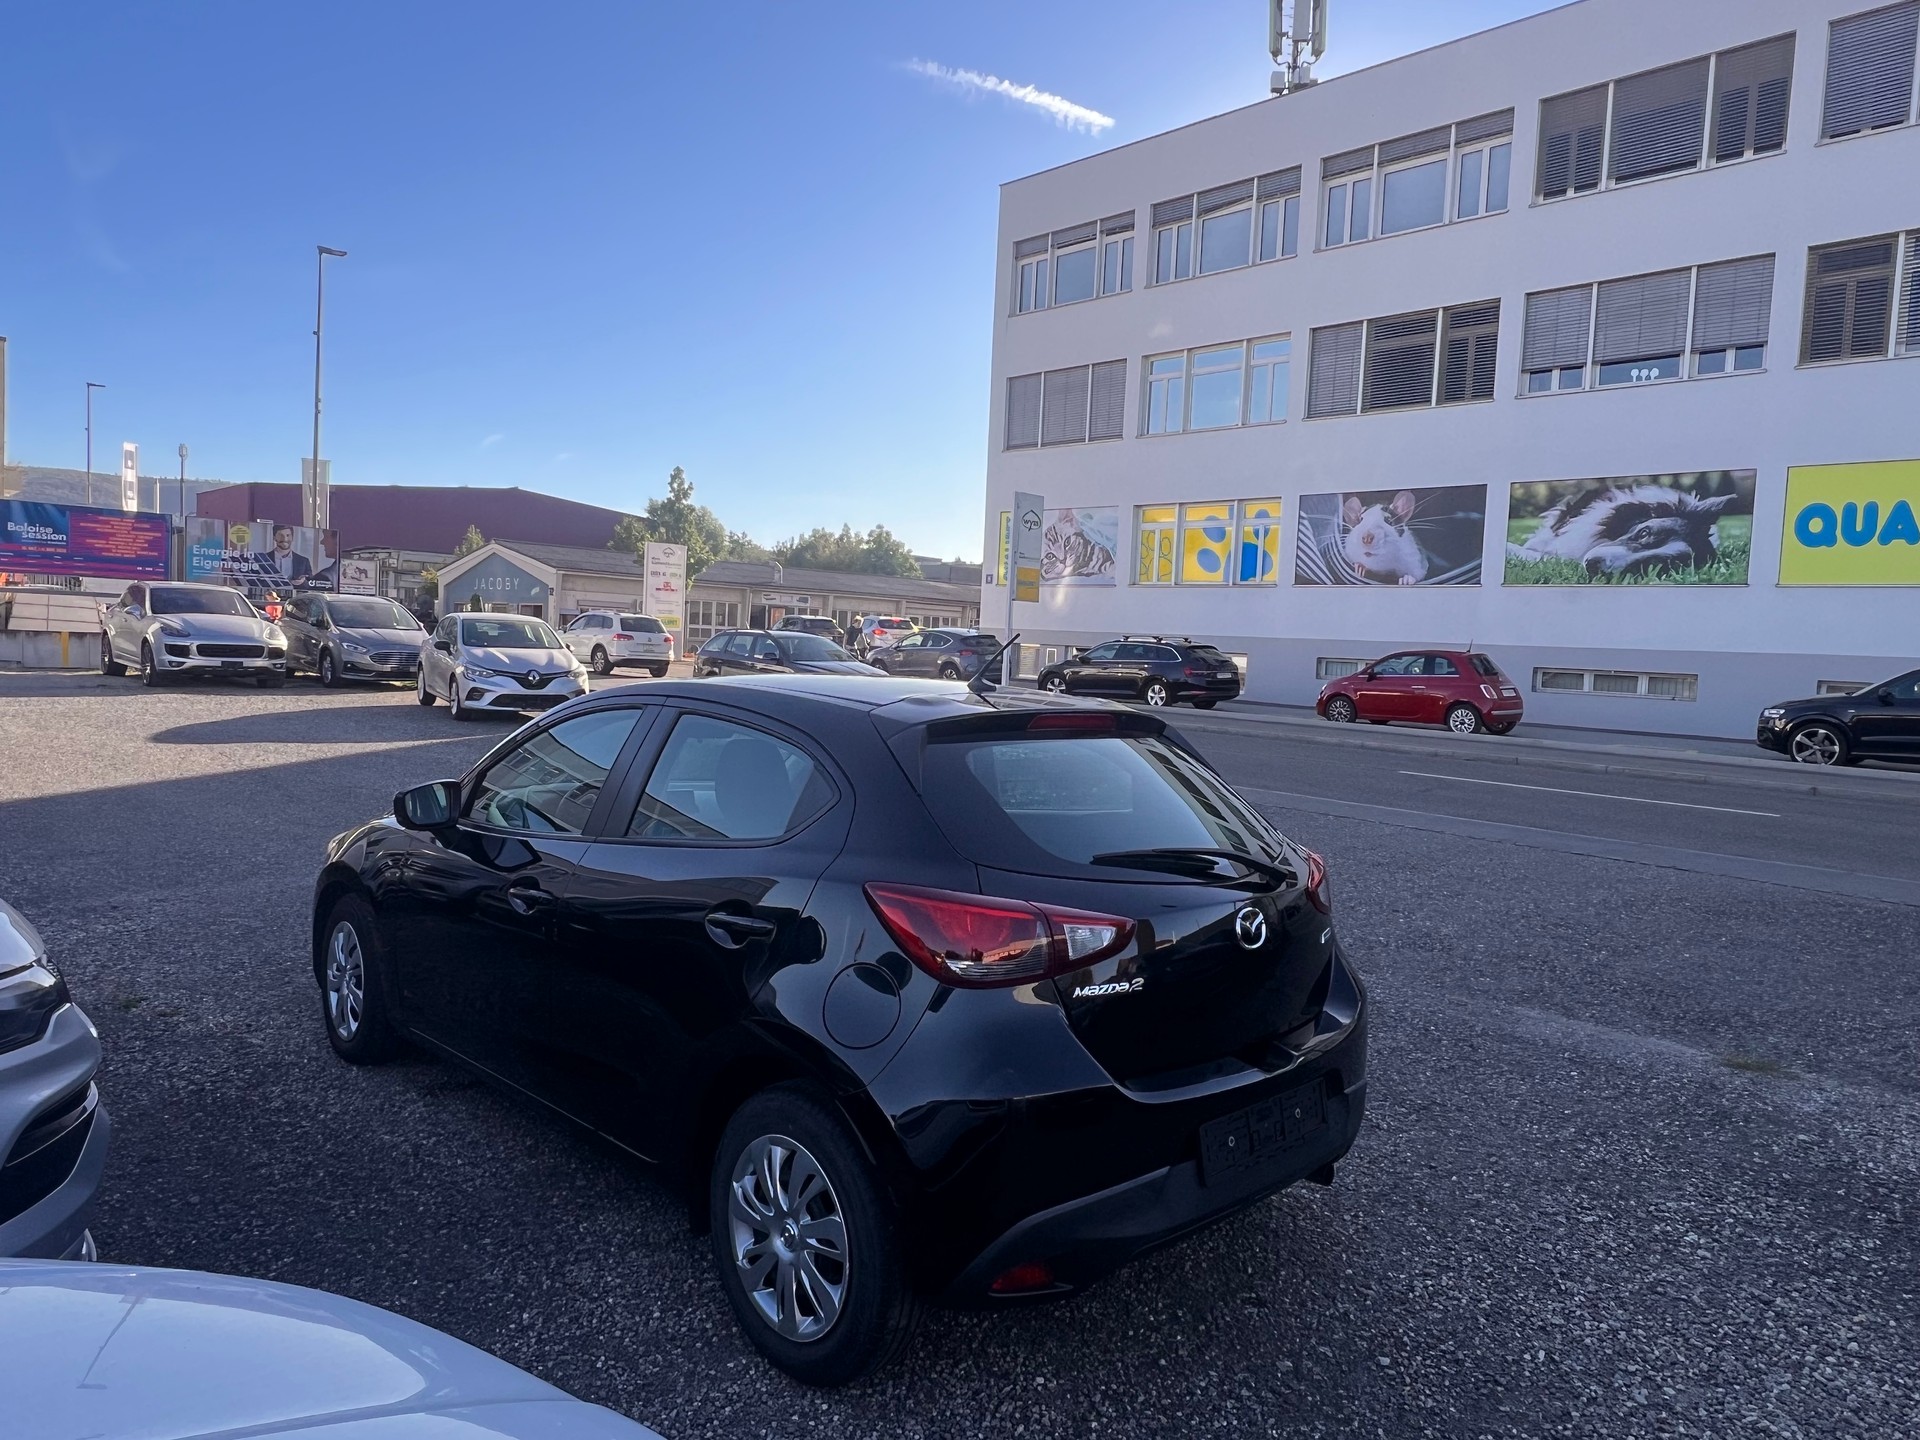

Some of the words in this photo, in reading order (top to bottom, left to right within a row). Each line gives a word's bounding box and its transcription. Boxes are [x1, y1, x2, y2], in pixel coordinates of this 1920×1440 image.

[1794, 499, 1920, 548] QUA
[193, 544, 240, 559] Energie
[193, 556, 259, 571] Eigenregie
[474, 577, 520, 590] JACOBY
